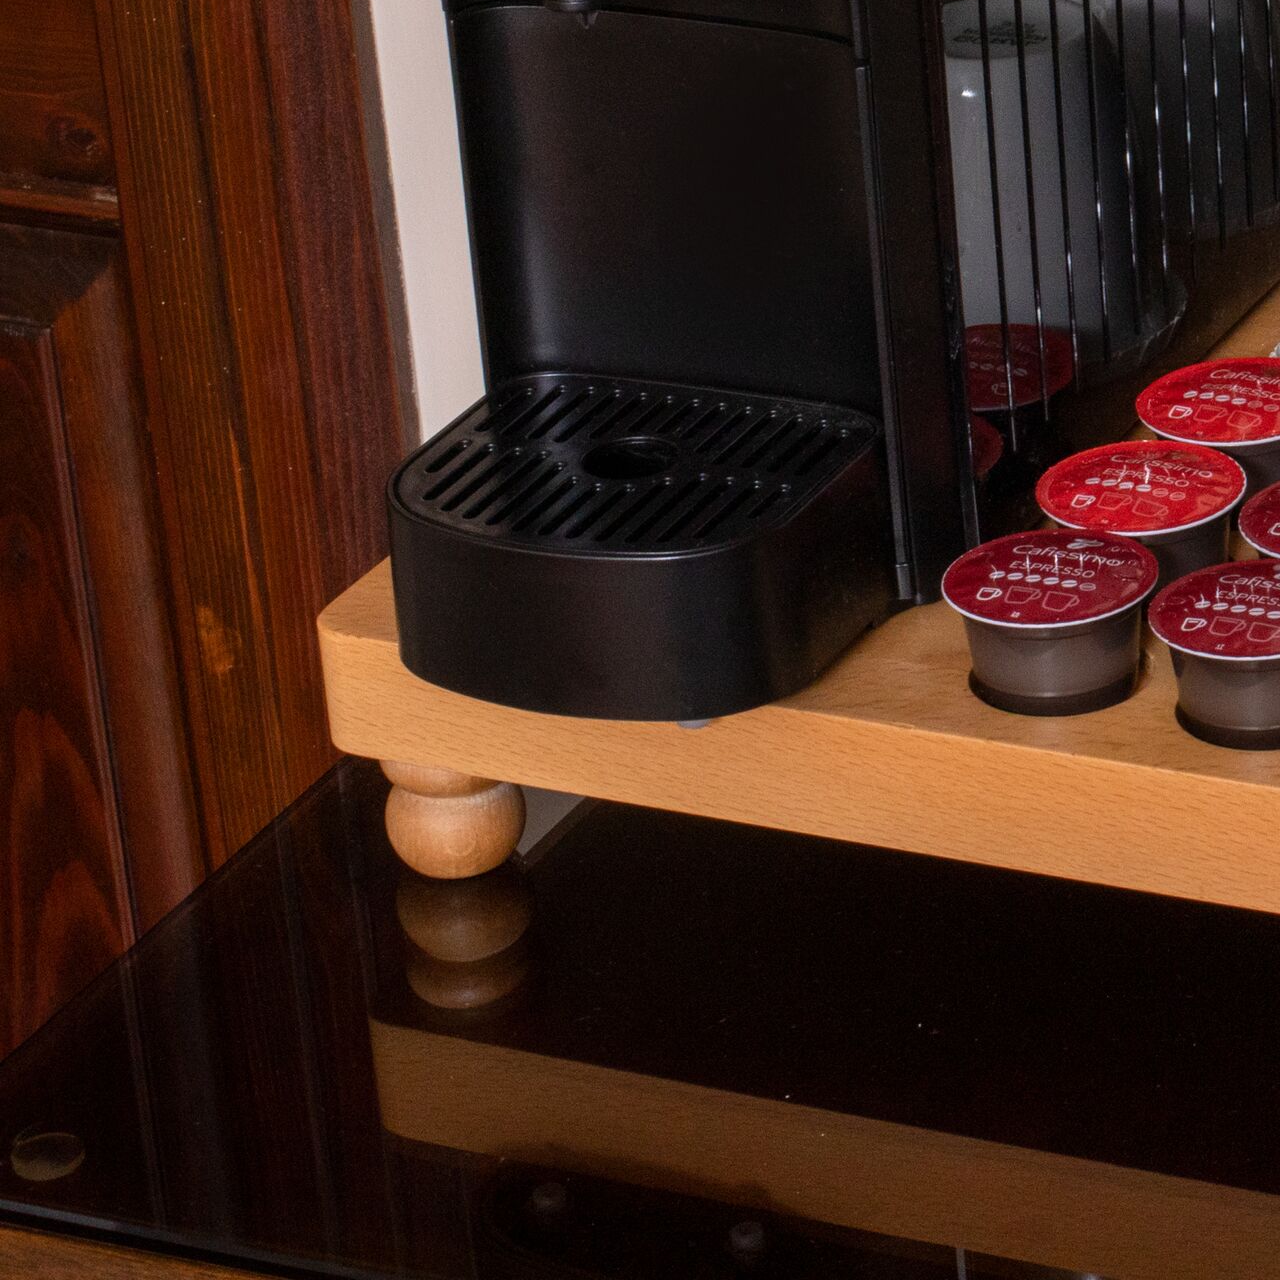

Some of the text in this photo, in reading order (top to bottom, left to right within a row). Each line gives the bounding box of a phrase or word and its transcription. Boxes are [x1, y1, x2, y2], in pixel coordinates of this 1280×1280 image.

[1102, 467, 1190, 488] ESPRESSO
[1111, 454, 1214, 479] Cafissimo
[1012, 544, 1122, 567] Cafissimo
[1009, 559, 1096, 579] ESPRESSO
